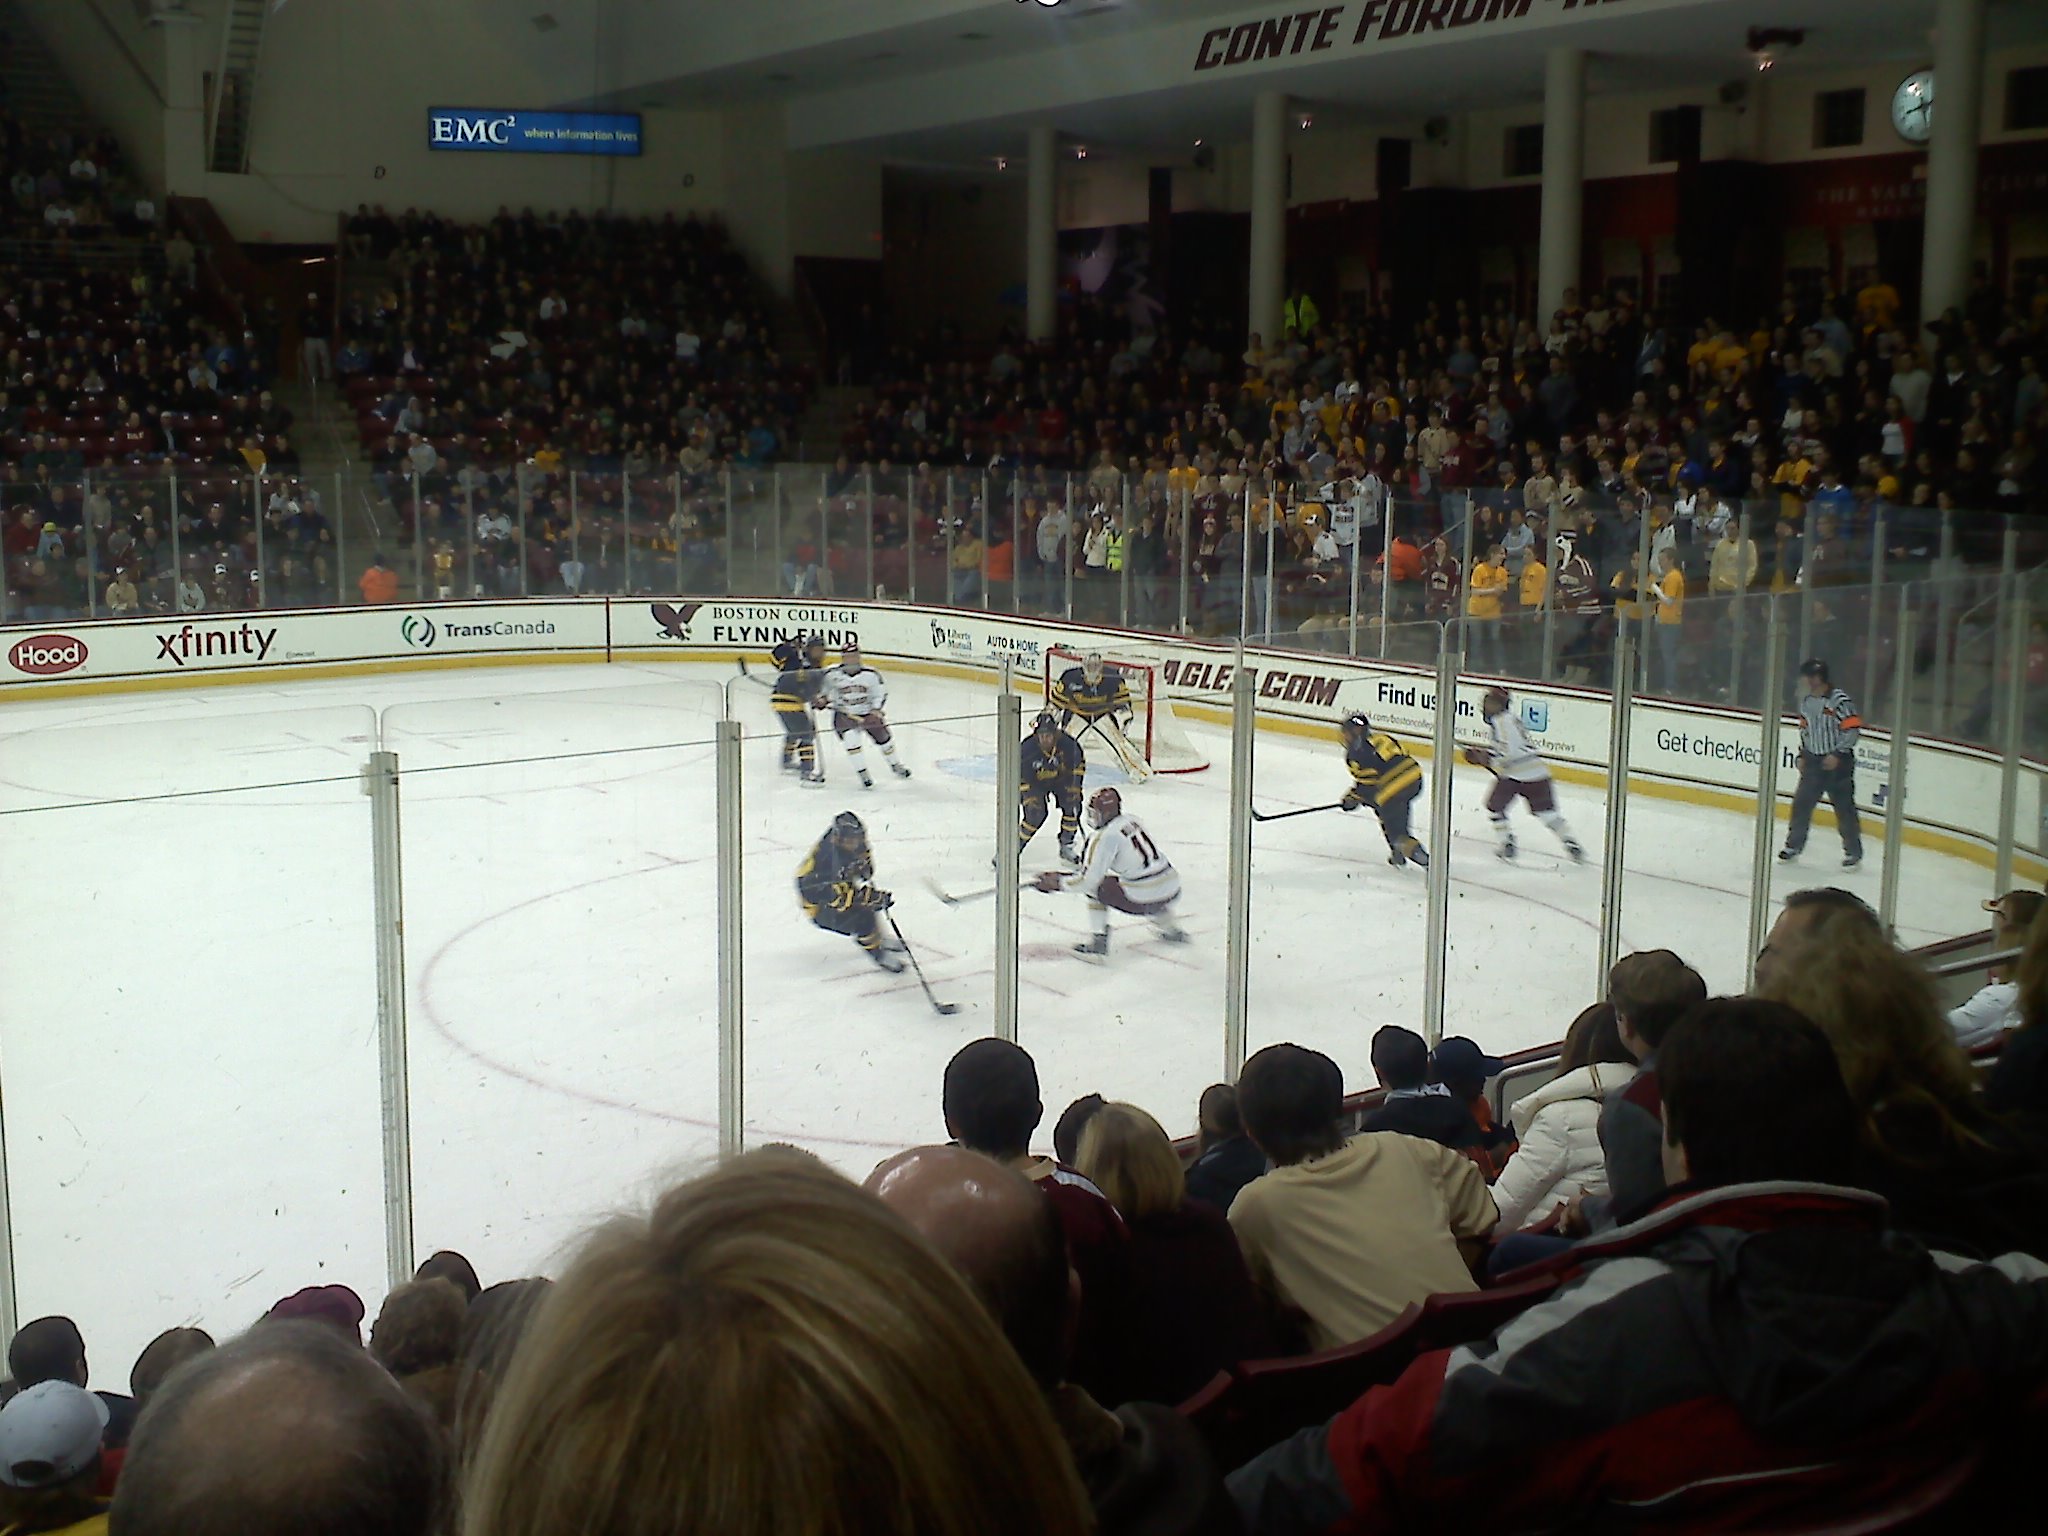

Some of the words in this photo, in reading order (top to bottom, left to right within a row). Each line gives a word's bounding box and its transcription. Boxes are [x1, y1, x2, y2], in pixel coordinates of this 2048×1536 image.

[1194, 6, 1346, 71] CONTE
[524, 127, 555, 139] where
[557, 128, 615, 141] information
[616, 130, 639, 142] lives
[713, 606, 781, 622] BOSTON
[787, 608, 859, 625] COLLEGE
[444, 619, 556, 638] TransCanada
[713, 625, 787, 645] FLYNN
[17, 642, 80, 667] Hood
[156, 622, 277, 666] xfinity
[987, 635, 1008, 649] AUTO
[1016, 639, 1039, 652] HOME
[1378, 682, 1416, 707] Find
[1421, 693, 1436, 711] us
[1657, 728, 1688, 754] Get
